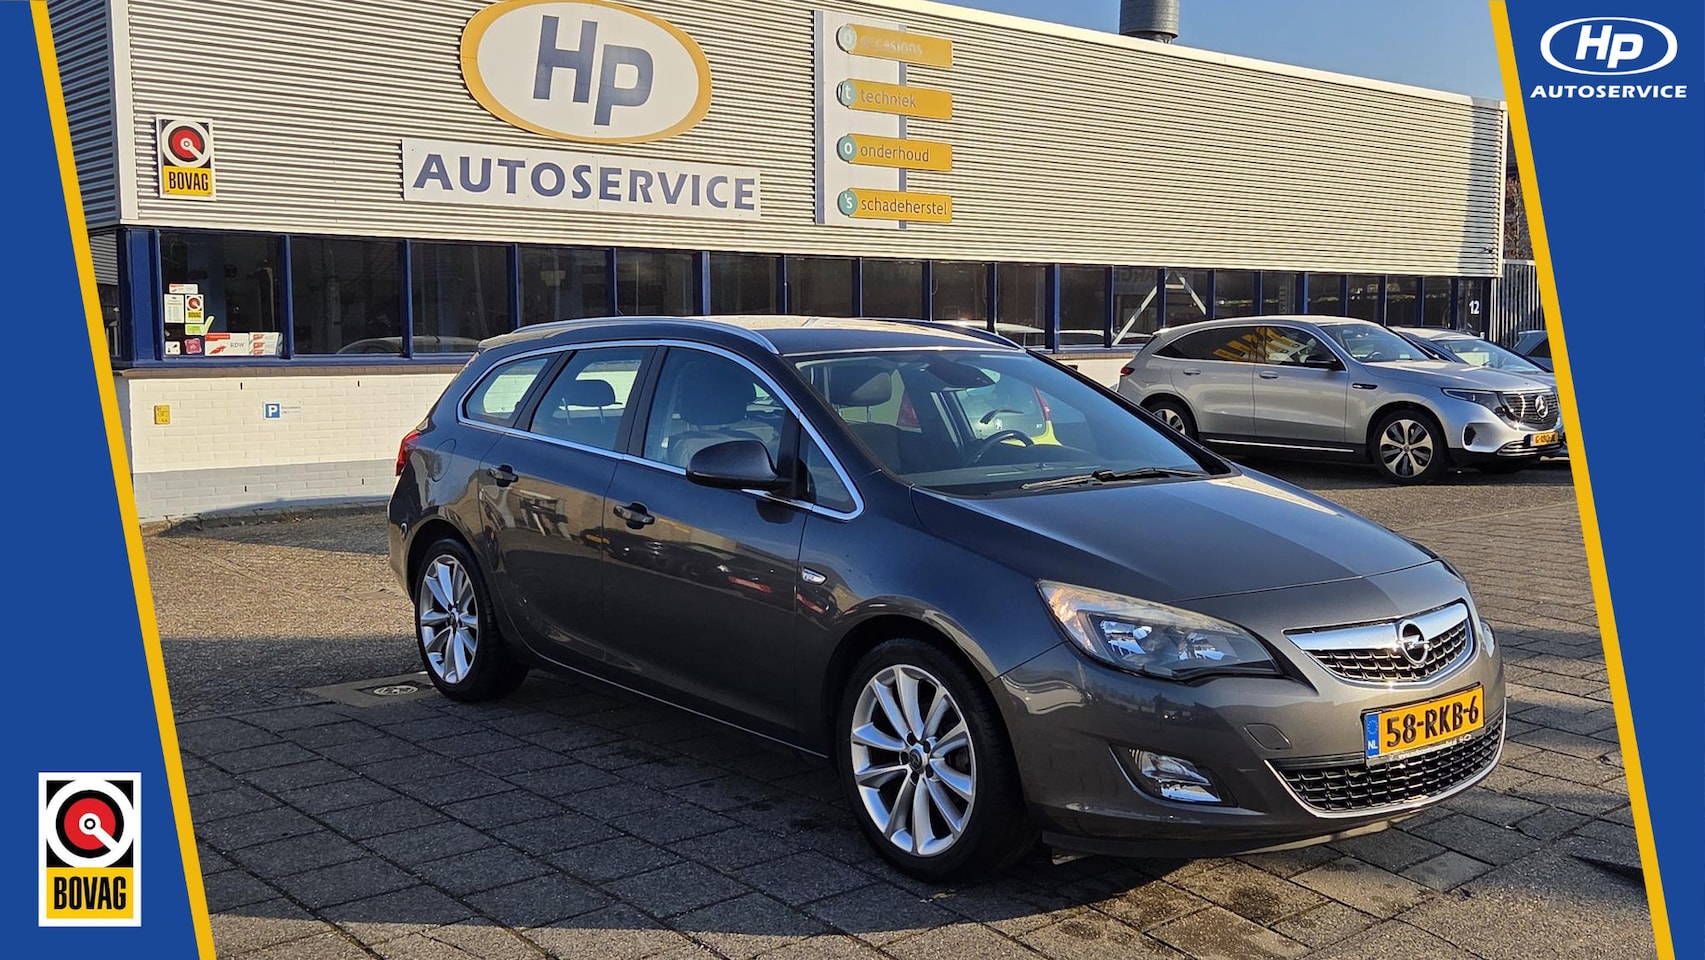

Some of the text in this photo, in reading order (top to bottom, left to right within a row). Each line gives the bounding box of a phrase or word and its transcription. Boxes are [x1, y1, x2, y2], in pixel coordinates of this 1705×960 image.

[860, 88, 917, 108] techniek
[860, 144, 930, 162] onderhoud
[168, 171, 209, 191] BOVAG
[413, 153, 756, 211] AUTOSERVICE
[861, 197, 947, 215] schadeherstel
[1469, 300, 1480, 315] 12
[1386, 695, 1479, 747] 58-RKB-6
[1367, 739, 1378, 749] NL
